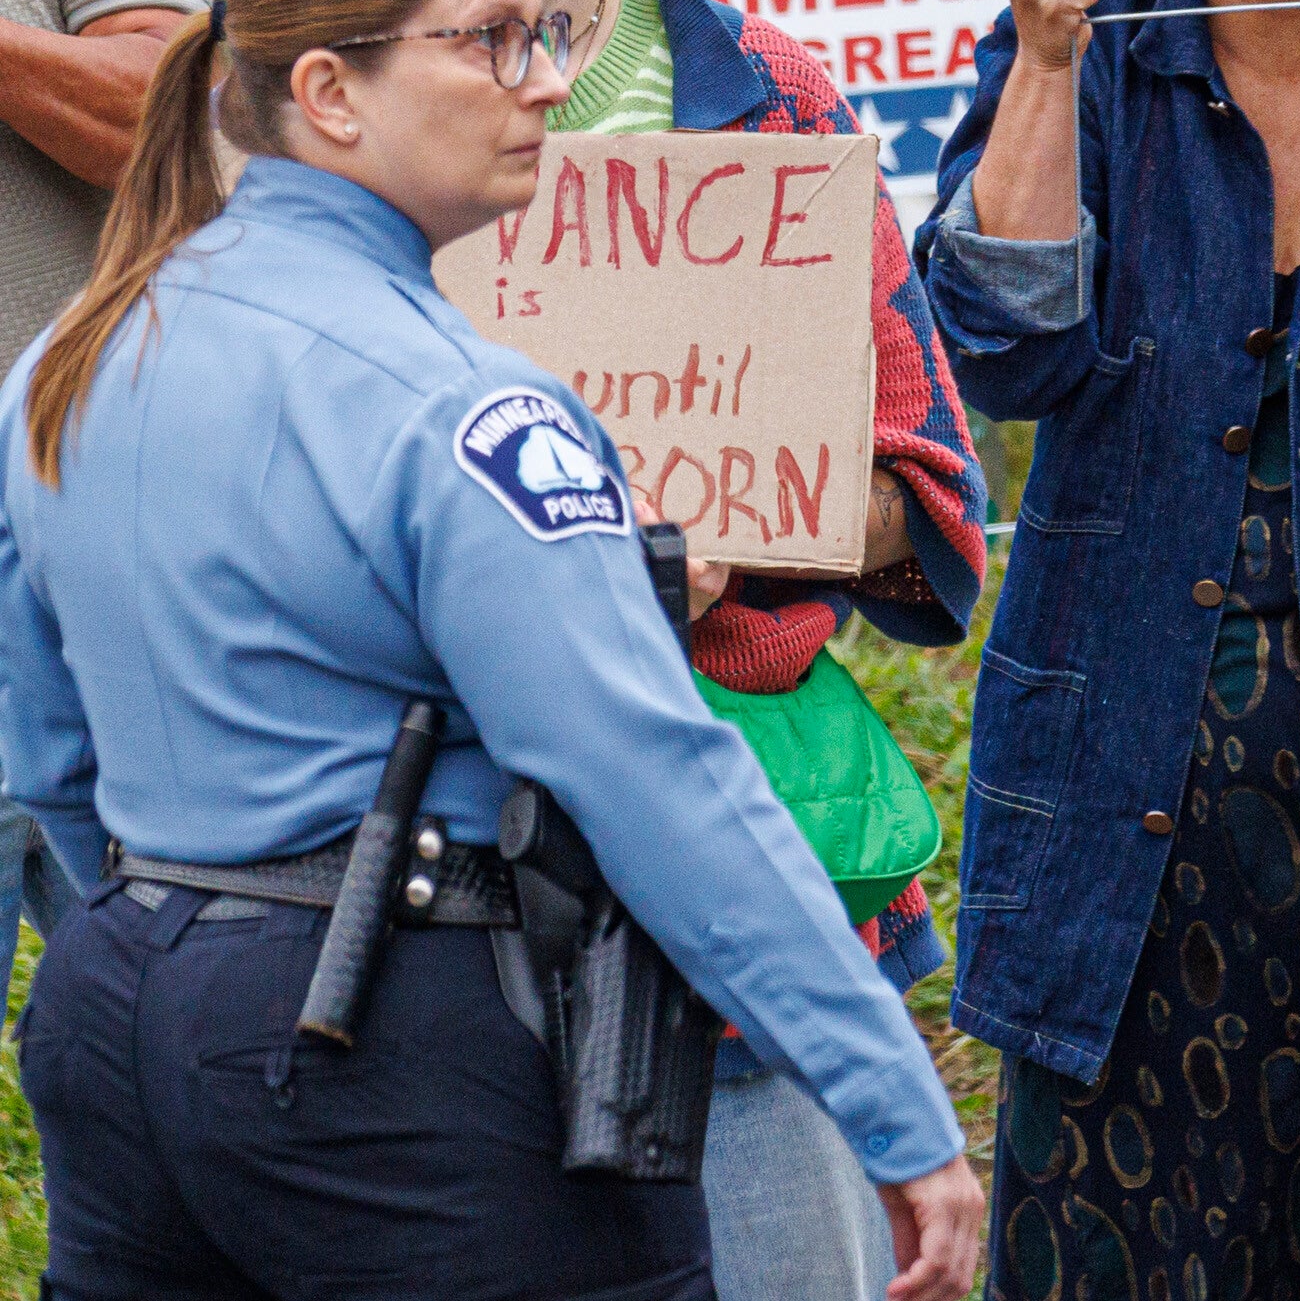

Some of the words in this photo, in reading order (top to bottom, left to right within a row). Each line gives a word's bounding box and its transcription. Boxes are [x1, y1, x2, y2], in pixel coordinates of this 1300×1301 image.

[497, 155, 833, 270] VANCE
[495, 277, 543, 320] is
[572, 343, 752, 422] until
[543, 492, 619, 525] POLICE
